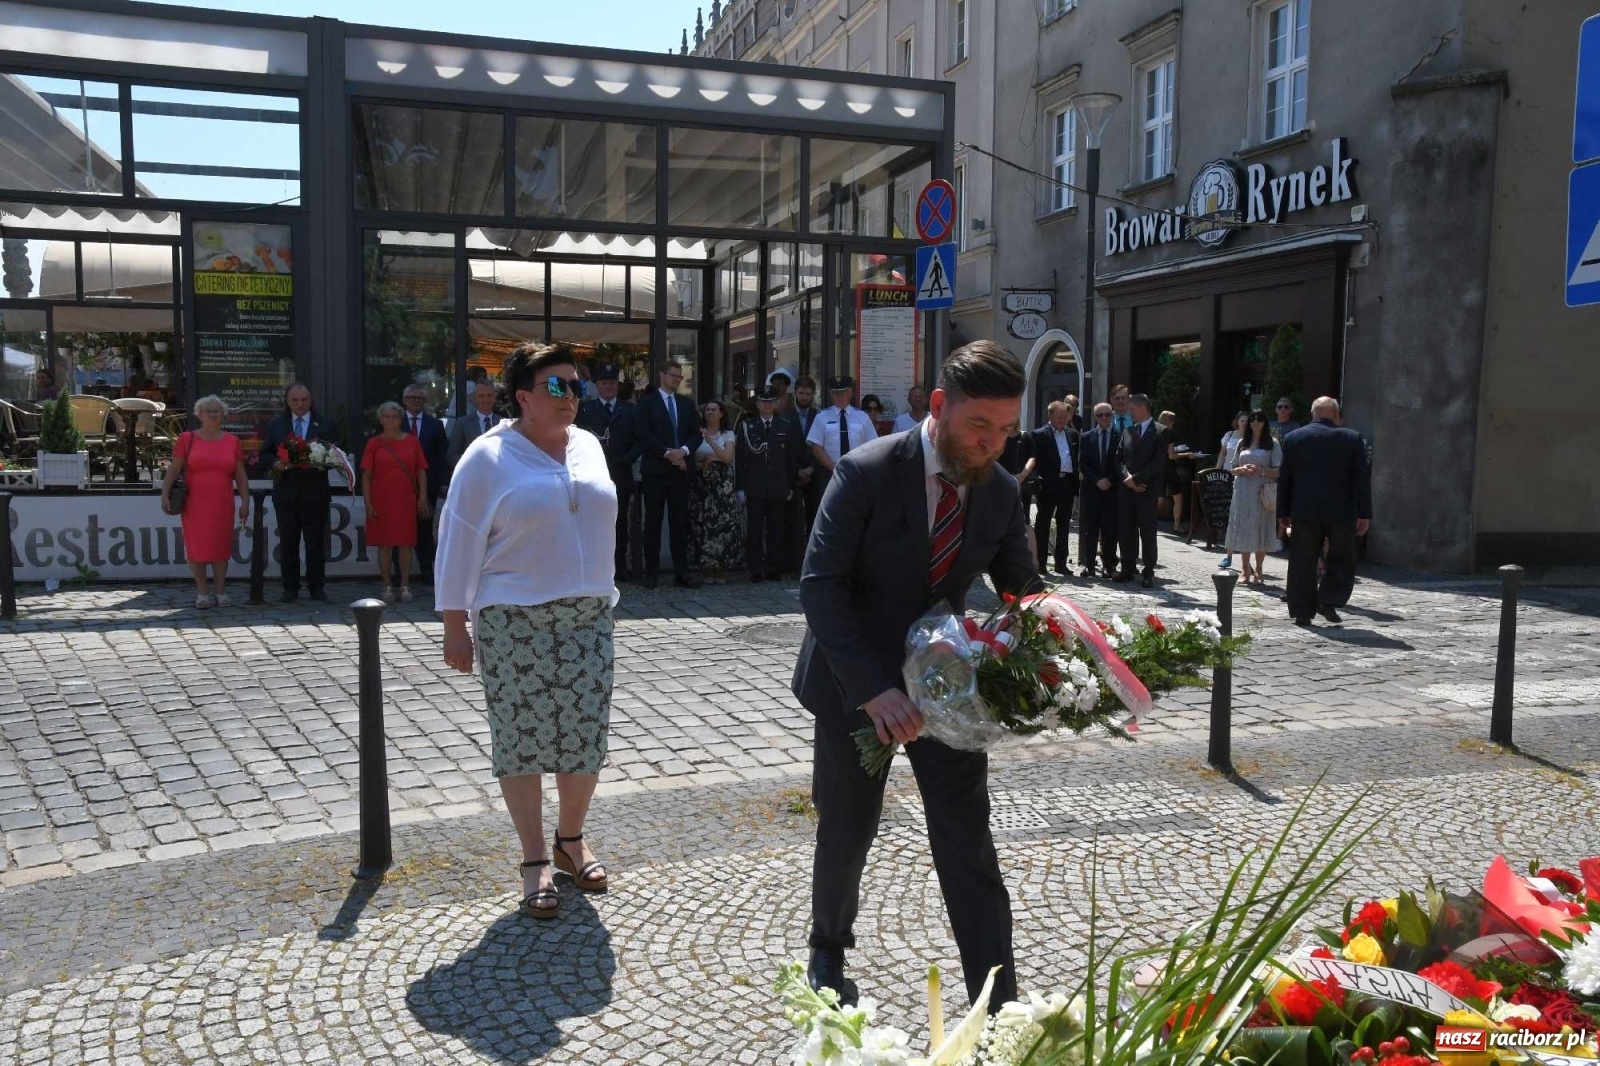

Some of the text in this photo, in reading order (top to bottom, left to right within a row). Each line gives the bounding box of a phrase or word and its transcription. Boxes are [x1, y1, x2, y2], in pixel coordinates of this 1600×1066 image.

[1105, 138, 1352, 257] Browar Rynek
[195, 275, 290, 293] CATERING DIETETYCZNY
[869, 289, 909, 302] LUNCH
[236, 299, 289, 311] BEZ PSZENICY
[1206, 472, 1230, 482] HEINZ
